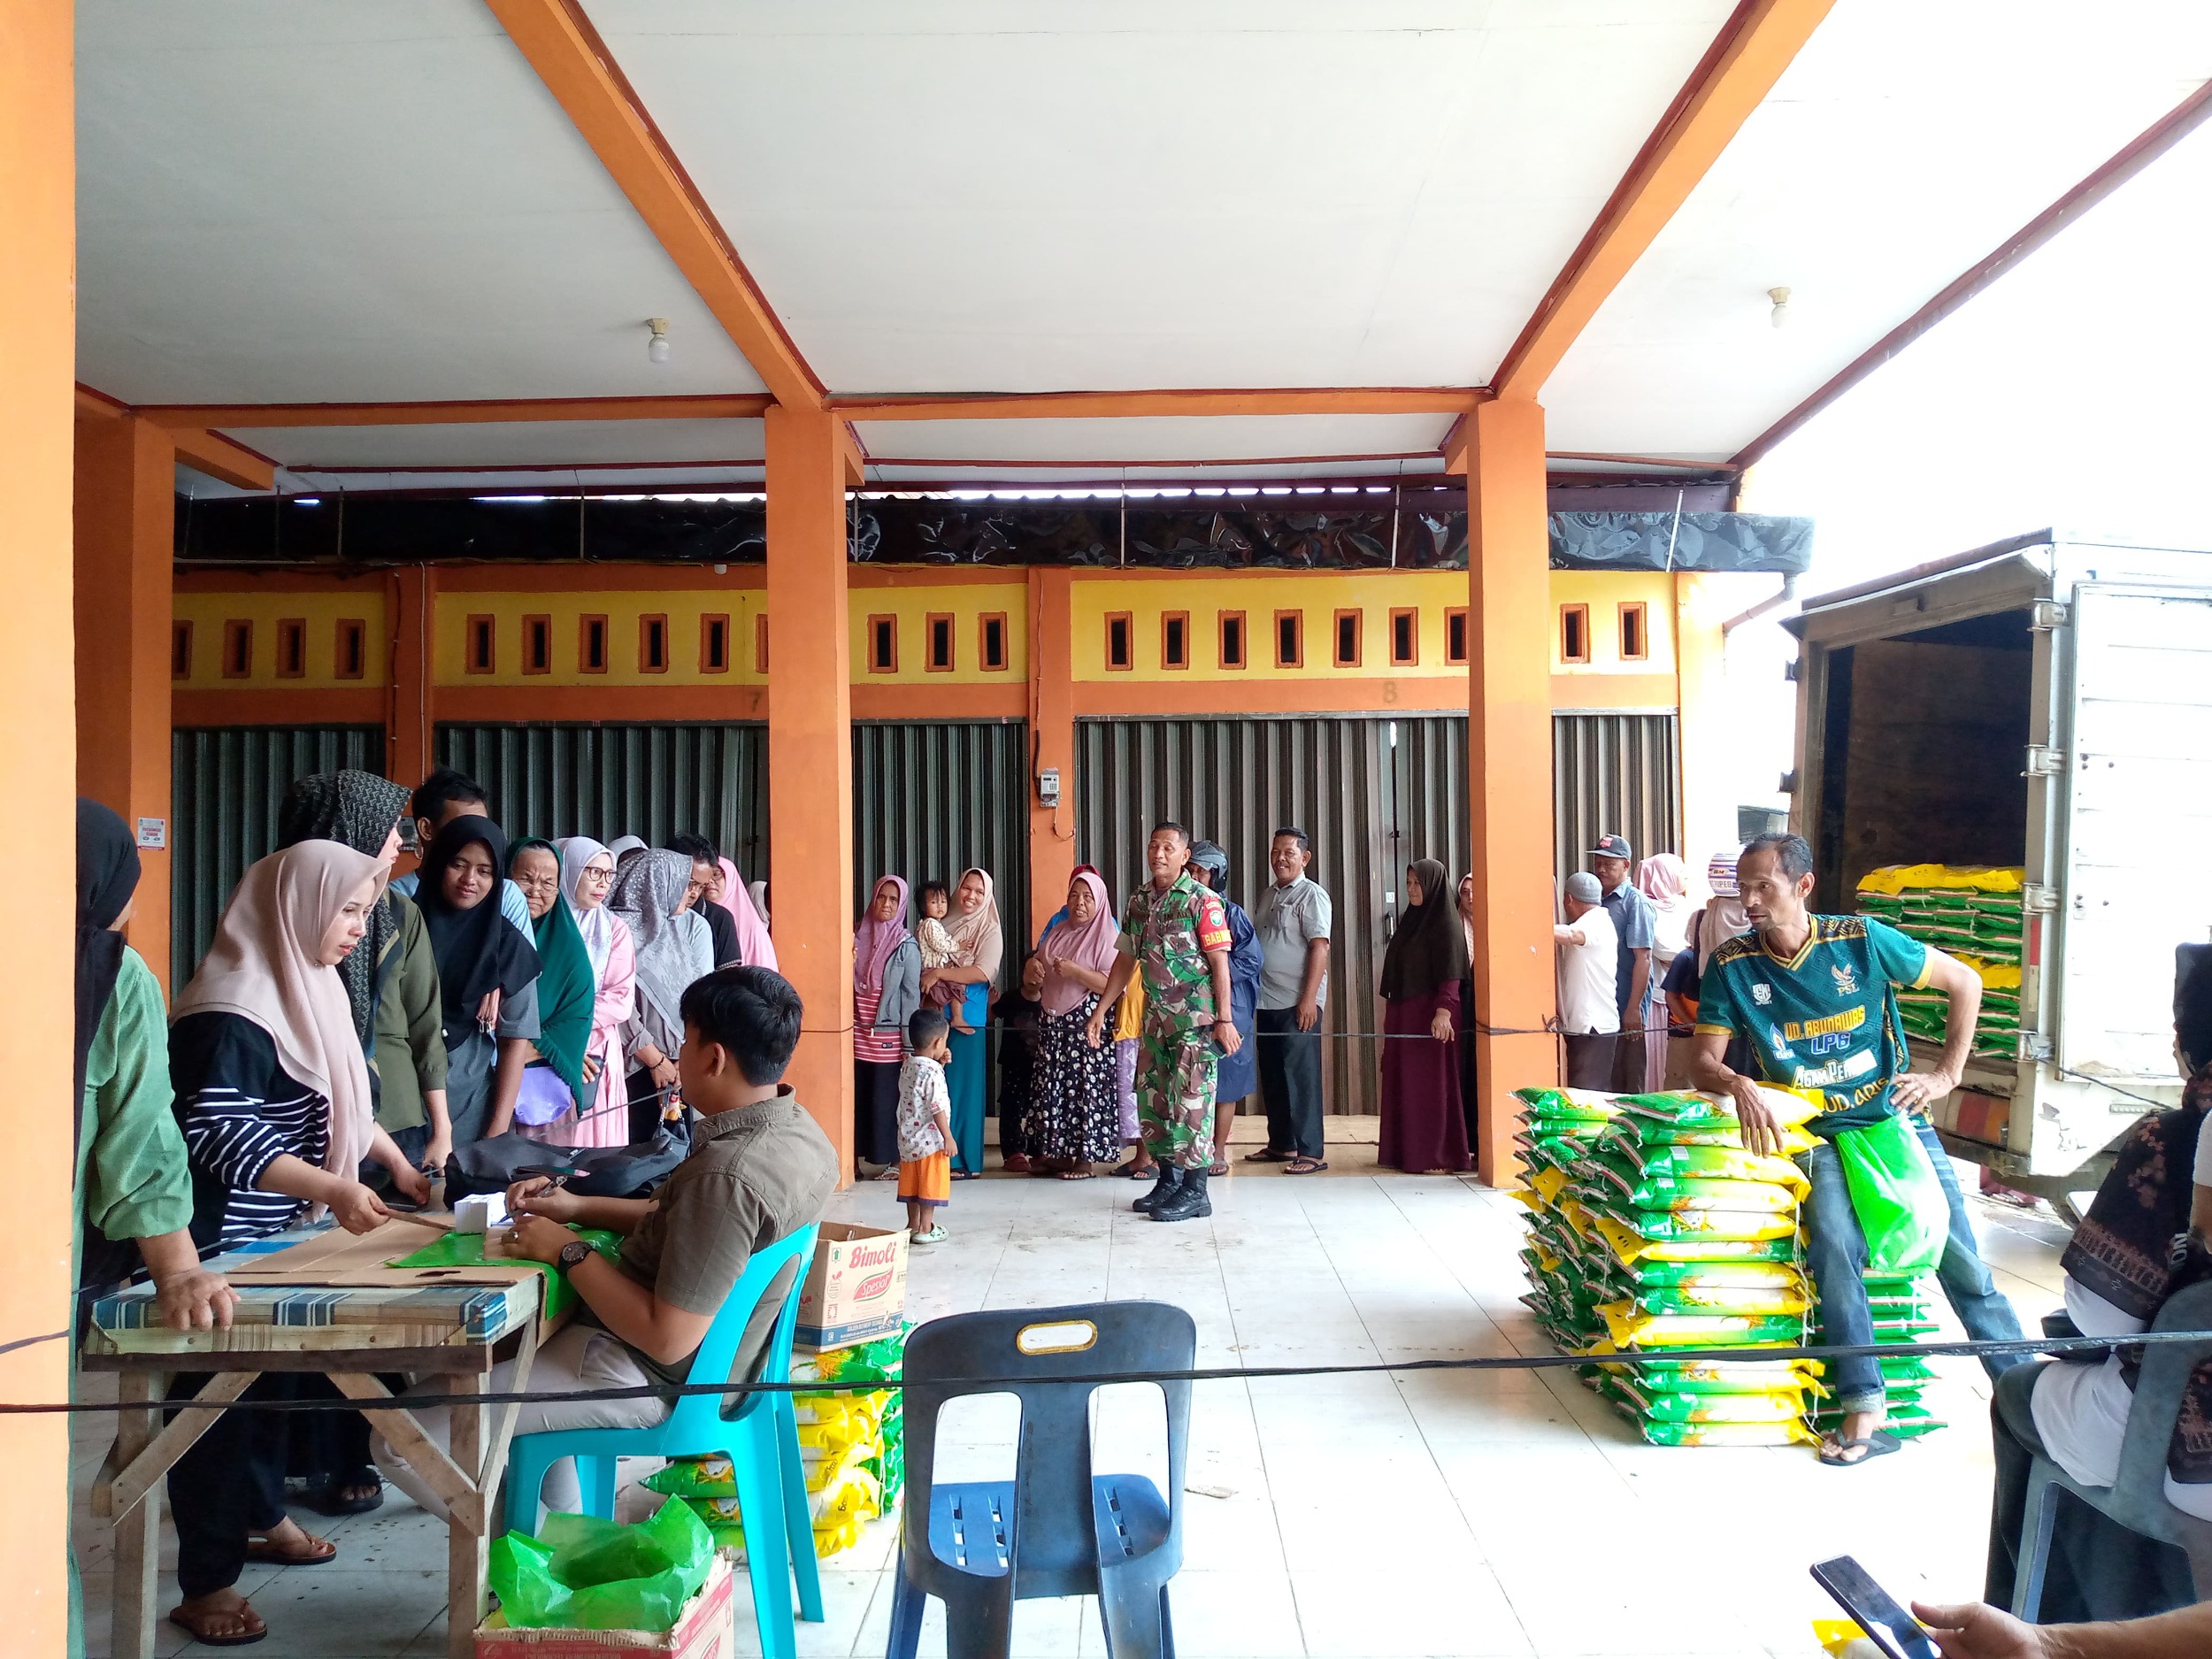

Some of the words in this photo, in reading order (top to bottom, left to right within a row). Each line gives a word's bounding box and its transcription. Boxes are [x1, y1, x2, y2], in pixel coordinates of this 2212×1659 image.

[1383, 680, 1398, 703] 8
[1837, 983, 1860, 996] PSL
[1804, 1005, 1865, 1039] ABUNAWAS
[1854, 1077, 1890, 1106] ARIS
[849, 1241, 896, 1268] Bimoli
[861, 1274, 890, 1297] Spesial
